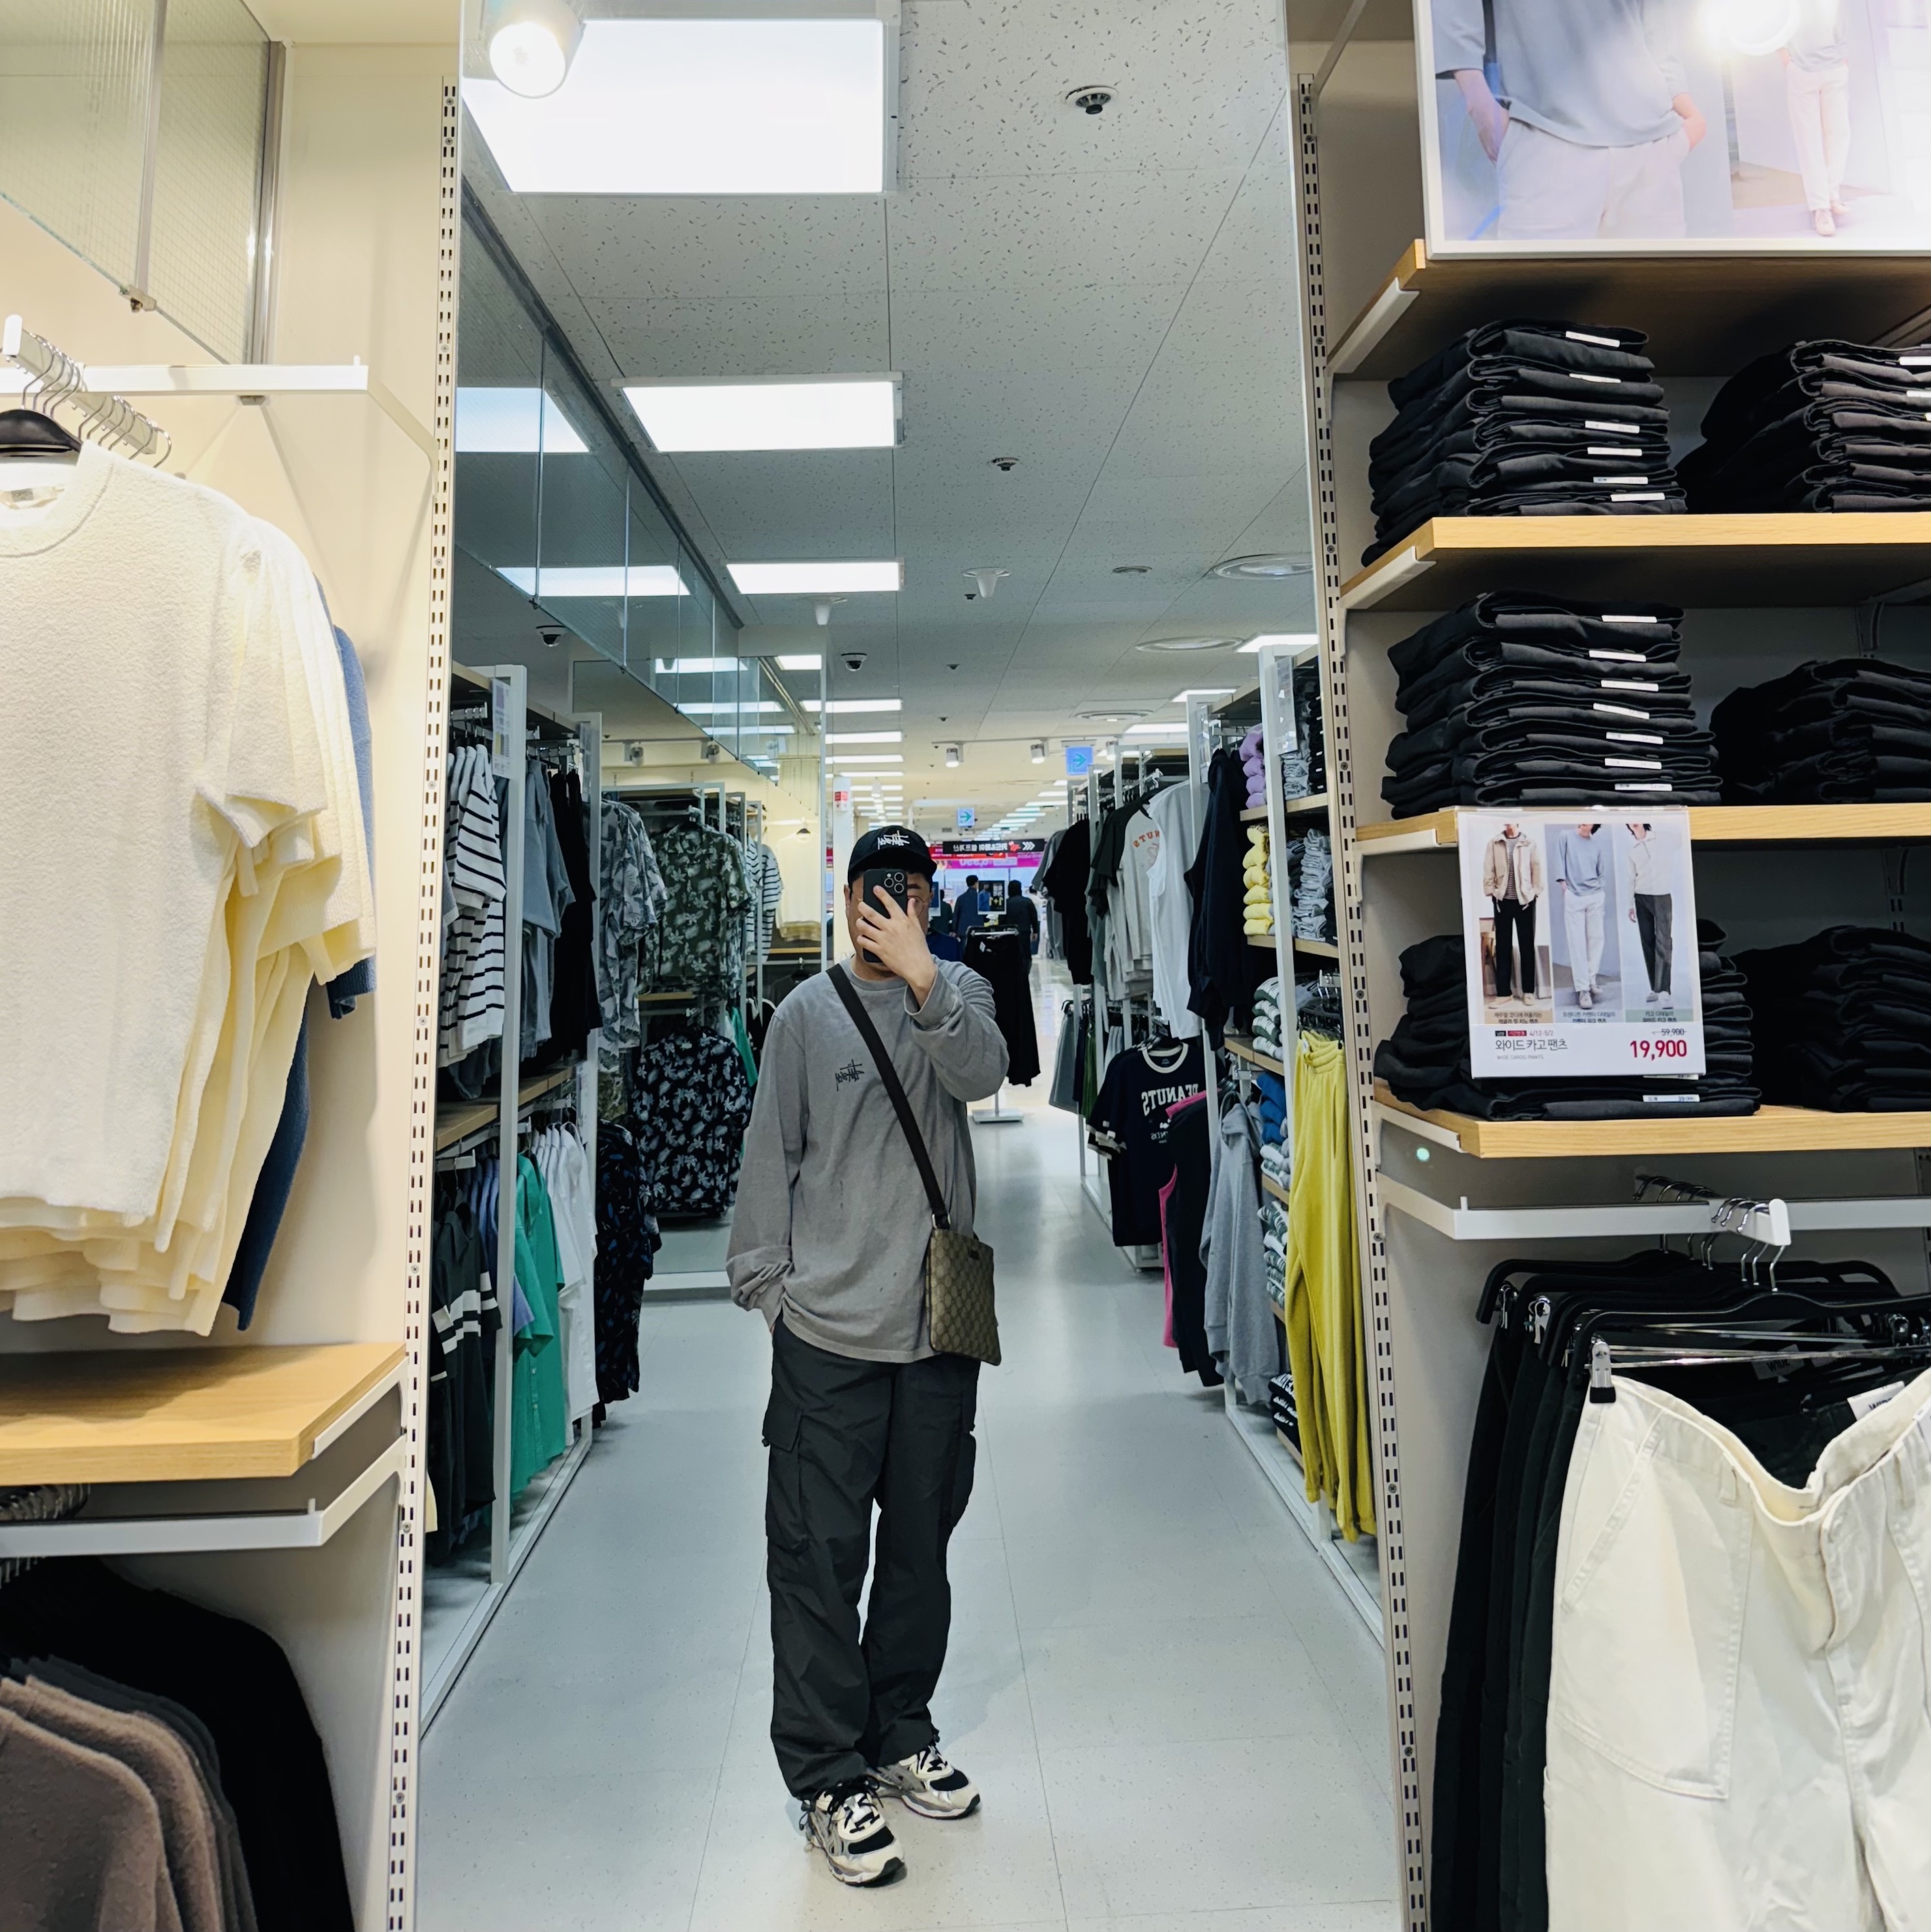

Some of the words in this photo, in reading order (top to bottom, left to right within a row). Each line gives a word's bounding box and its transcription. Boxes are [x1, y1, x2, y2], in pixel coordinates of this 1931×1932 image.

[1661, 1028, 1685, 1037] 59,900
[1495, 1039, 1525, 1051] 와이드
[1527, 1039, 1547, 1051] 카고
[1548, 1038, 1568, 1051] 팬츠
[1630, 1039, 1687, 1061] 19,900
[1868, 1397, 1893, 1410] WID
